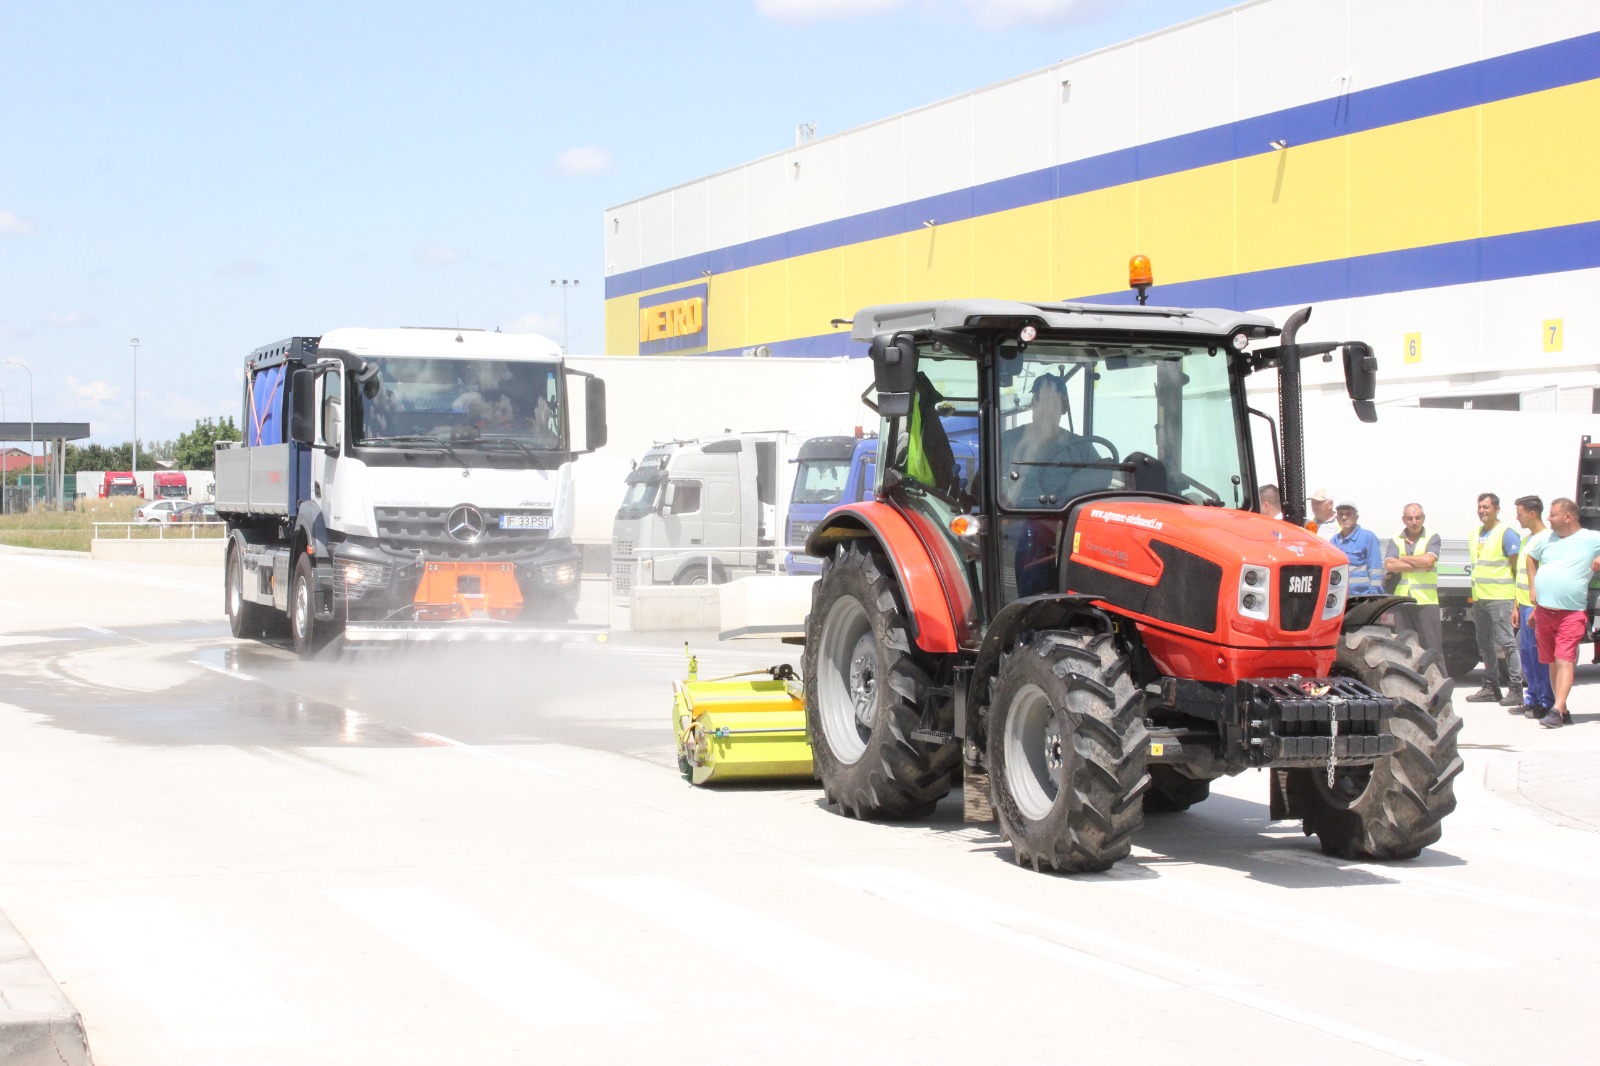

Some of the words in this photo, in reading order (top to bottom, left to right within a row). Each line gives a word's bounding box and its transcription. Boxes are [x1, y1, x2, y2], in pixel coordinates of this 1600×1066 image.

[640, 297, 703, 343] METRO
[1549, 326, 1557, 345] 7
[1409, 339, 1416, 357] 6
[519, 516, 530, 526] 33
[531, 516, 550, 527] PST
[1090, 509, 1164, 531] www.agromec-stefanesti.ro
[1288, 575, 1313, 593] SAME
